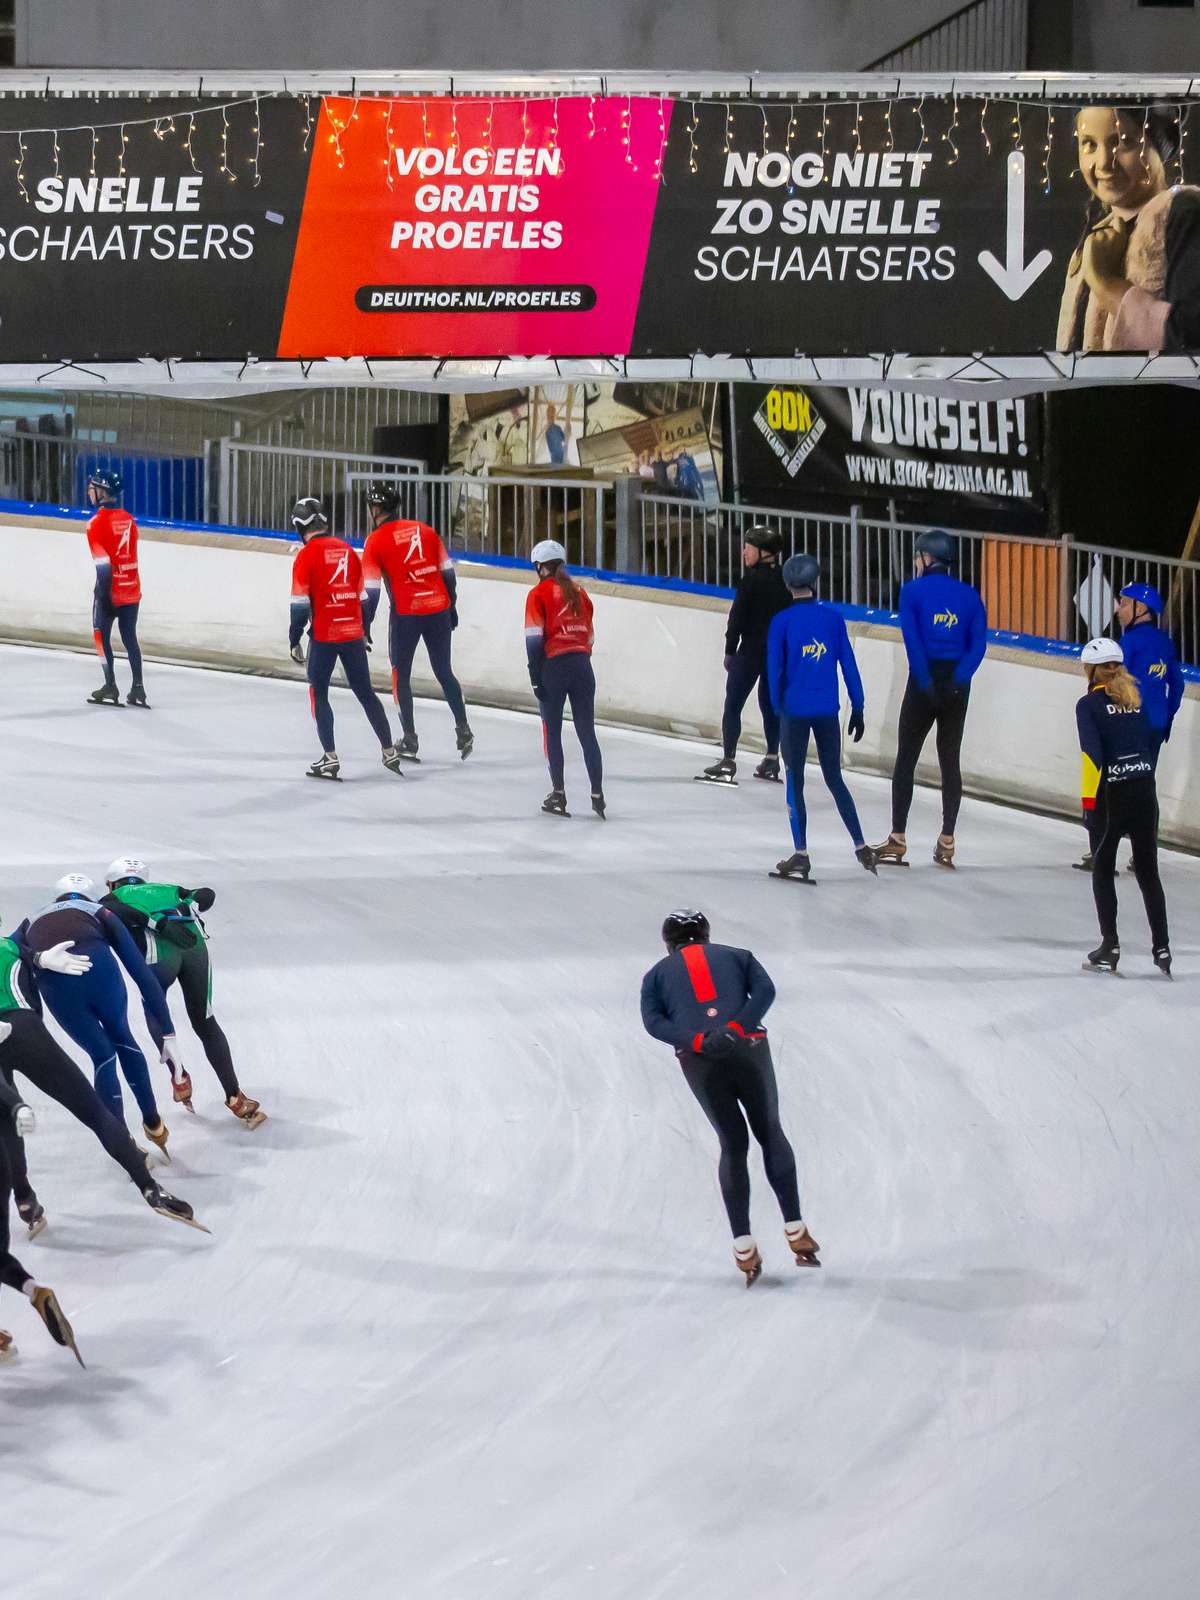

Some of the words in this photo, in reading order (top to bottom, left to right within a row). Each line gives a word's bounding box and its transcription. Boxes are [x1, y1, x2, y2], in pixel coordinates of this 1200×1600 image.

[395, 147, 490, 176] VOLG
[493, 147, 561, 176] EEN
[723, 152, 824, 188] NOG
[831, 152, 932, 188] NIET
[34, 176, 203, 213] SNELLE
[414, 184, 540, 213] GRATIS
[710, 199, 773, 234] ZO
[780, 199, 941, 234] SNELLE
[390, 221, 563, 250] PROEFLES
[694, 246, 956, 281] SCHAATSERS
[370, 291, 582, 307] DEUITHOF.NL/PROEFLES
[766, 389, 812, 433] BOK
[847, 386, 1028, 457] YOURSELF!
[845, 455, 1032, 498] WWW.BOK-DENHAAG.NL
